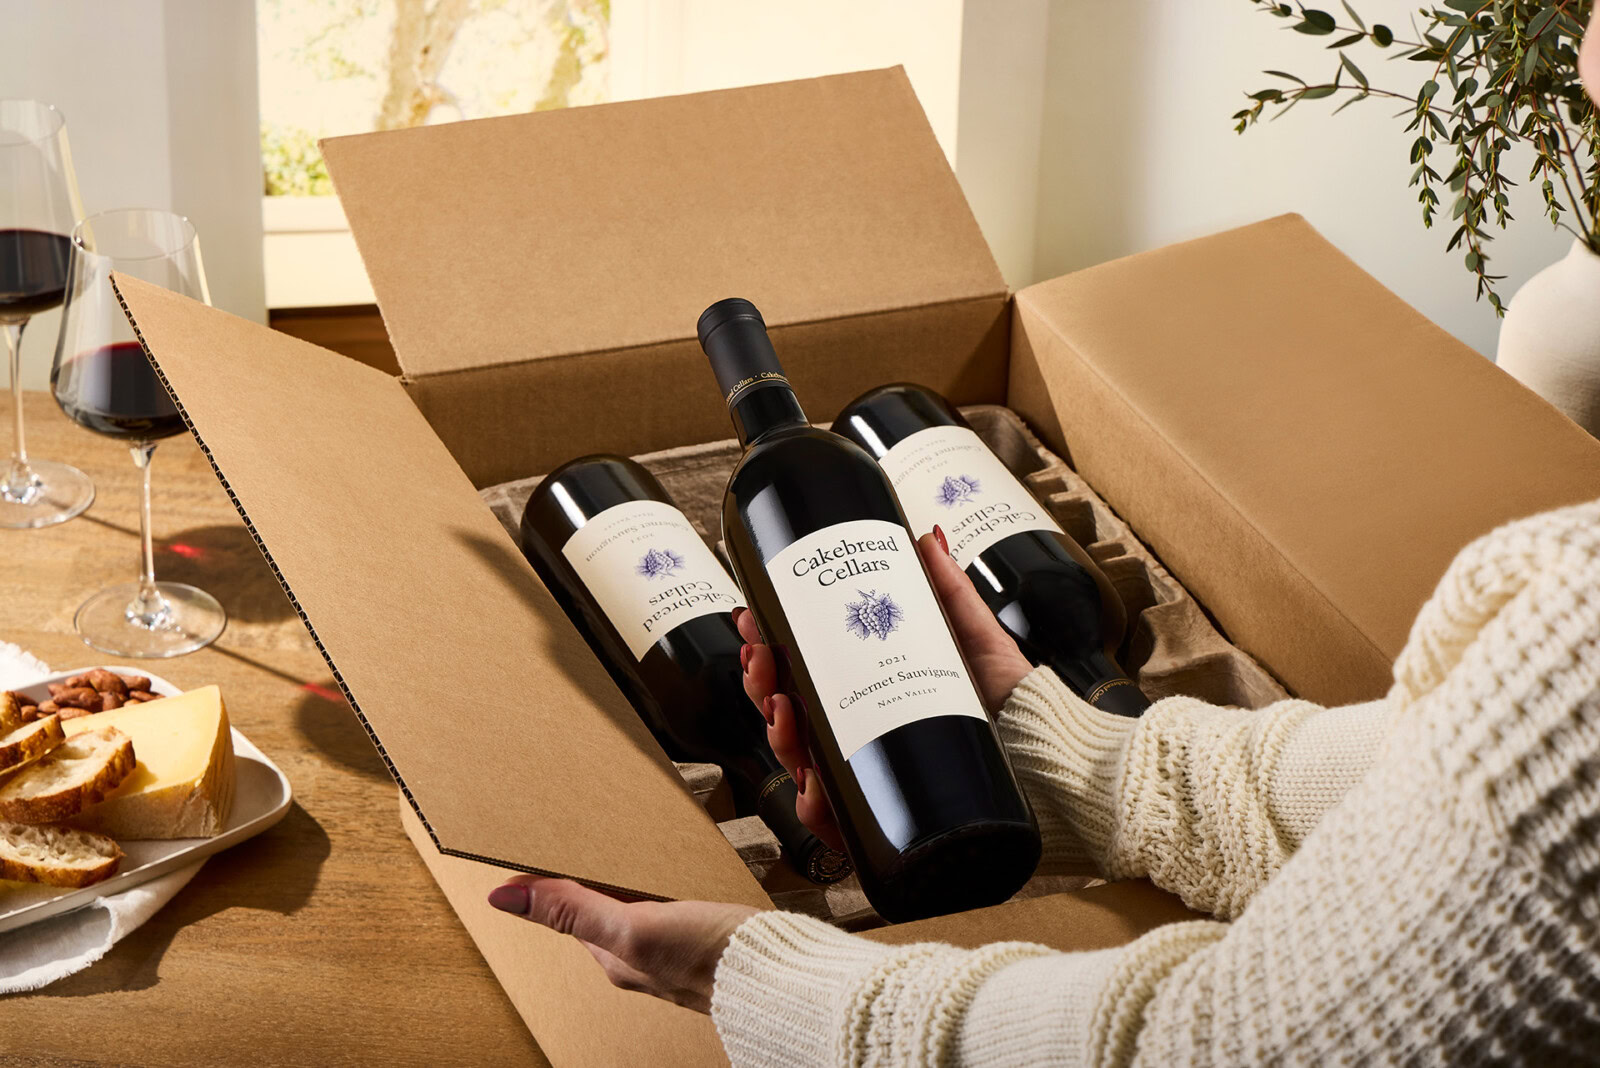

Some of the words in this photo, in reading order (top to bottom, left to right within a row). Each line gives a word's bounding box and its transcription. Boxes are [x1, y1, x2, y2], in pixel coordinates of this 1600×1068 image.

[952, 502, 1011, 534] Cellars
[792, 536, 899, 577] Cakebread
[817, 558, 890, 587] Cellars
[649, 581, 713, 606] Cellars
[642, 592, 737, 633] Cakebread
[878, 655, 907, 668] 2021
[839, 676, 895, 710] Cabernet
[897, 666, 960, 683] Sauvignon
